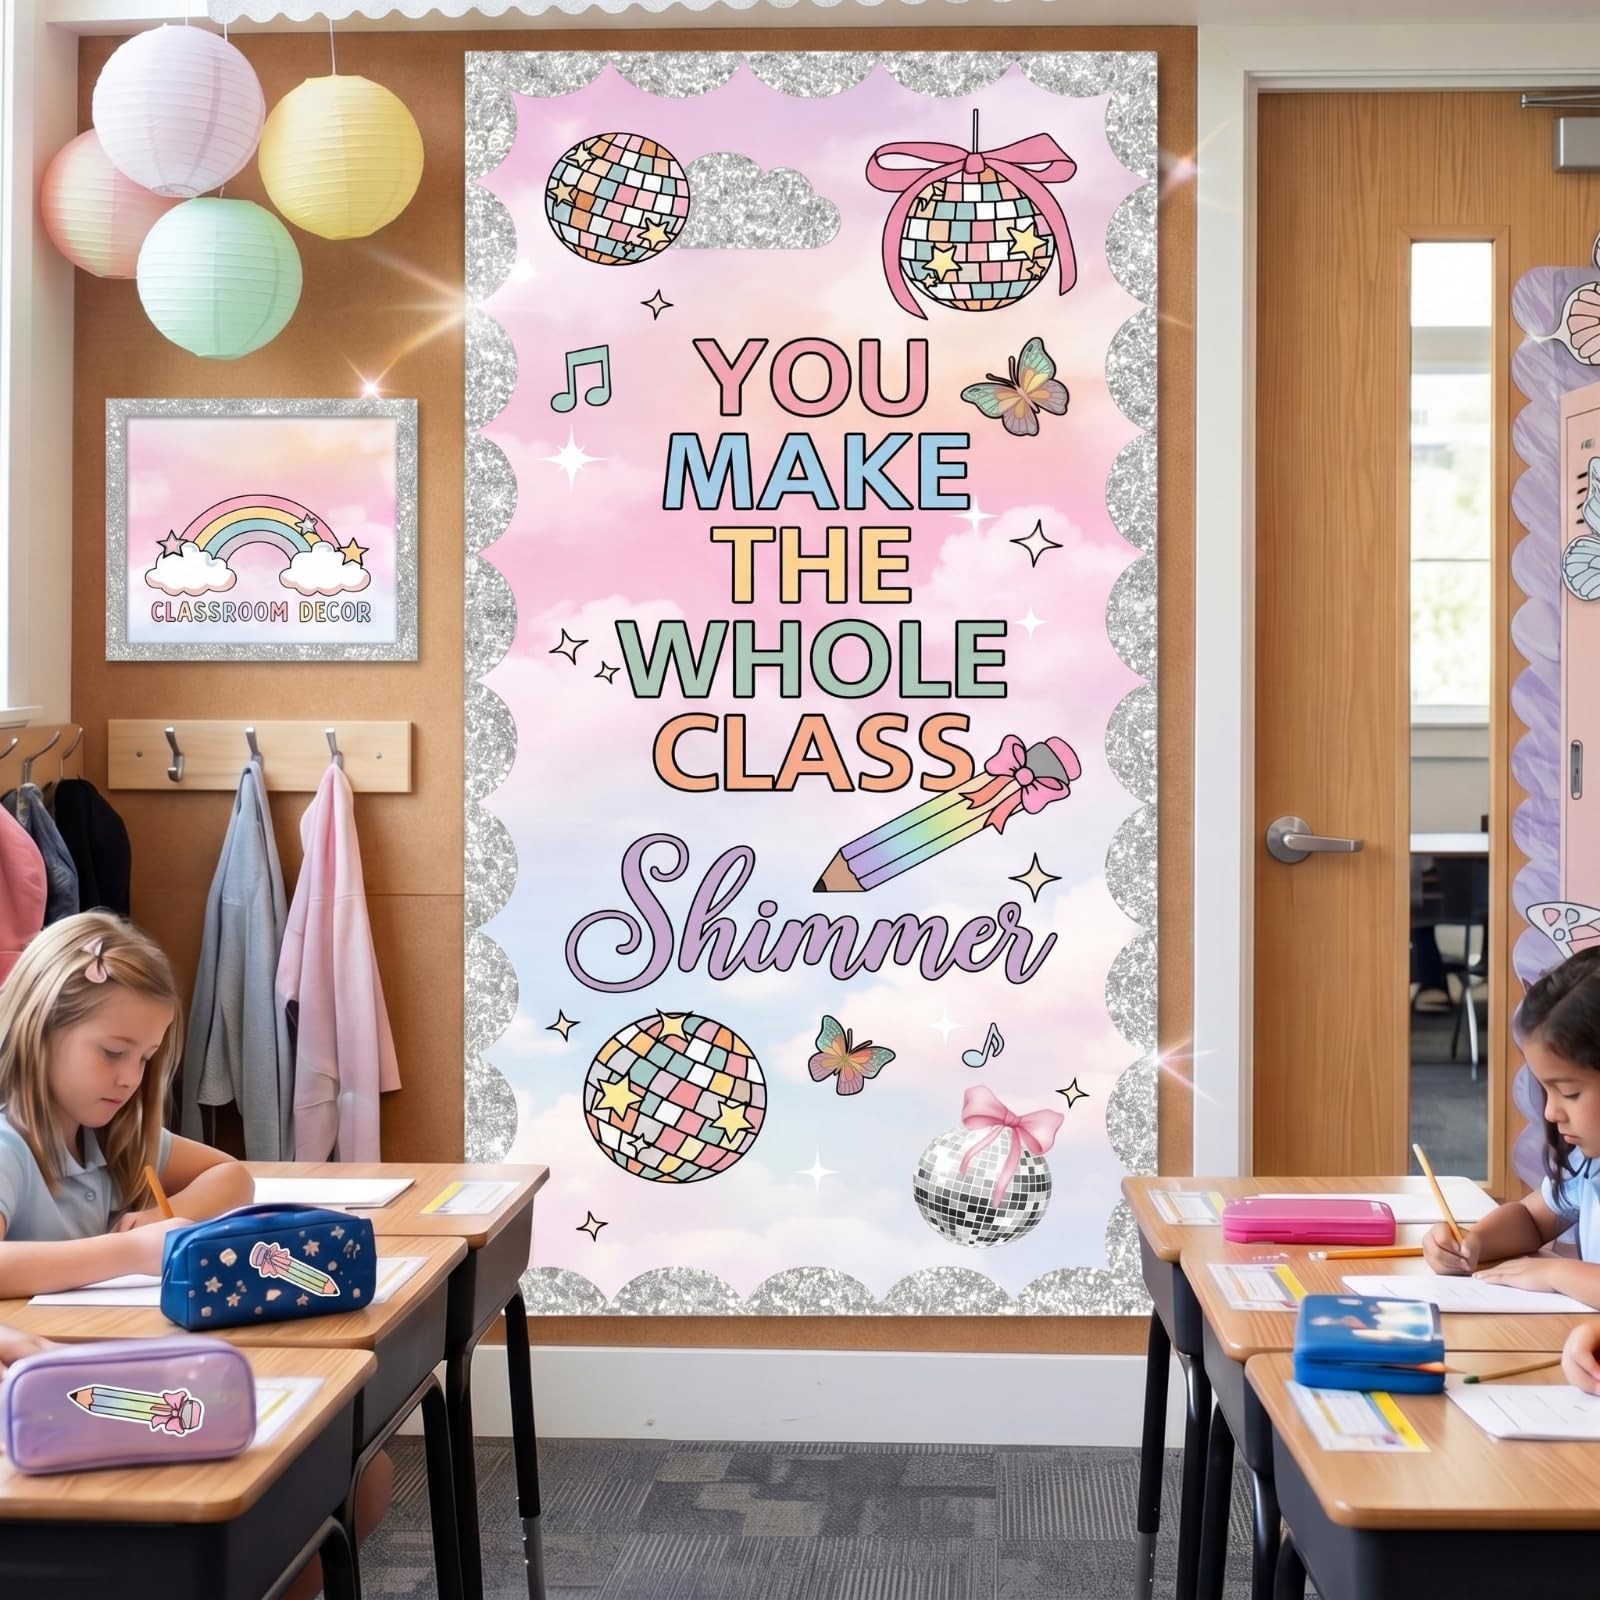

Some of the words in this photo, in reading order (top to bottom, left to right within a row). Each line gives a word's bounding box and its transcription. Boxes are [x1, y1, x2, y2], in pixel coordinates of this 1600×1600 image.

[693, 338, 929, 417] YOU
[662, 433, 970, 510] MAKE
[711, 526, 912, 604] THE
[151, 601, 288, 622] CLASSROOM
[299, 601, 371, 622] DECOR
[615, 620, 1008, 698] WHOLE
[652, 714, 976, 792] CLASS
[565, 833, 1058, 993] Shimmer
